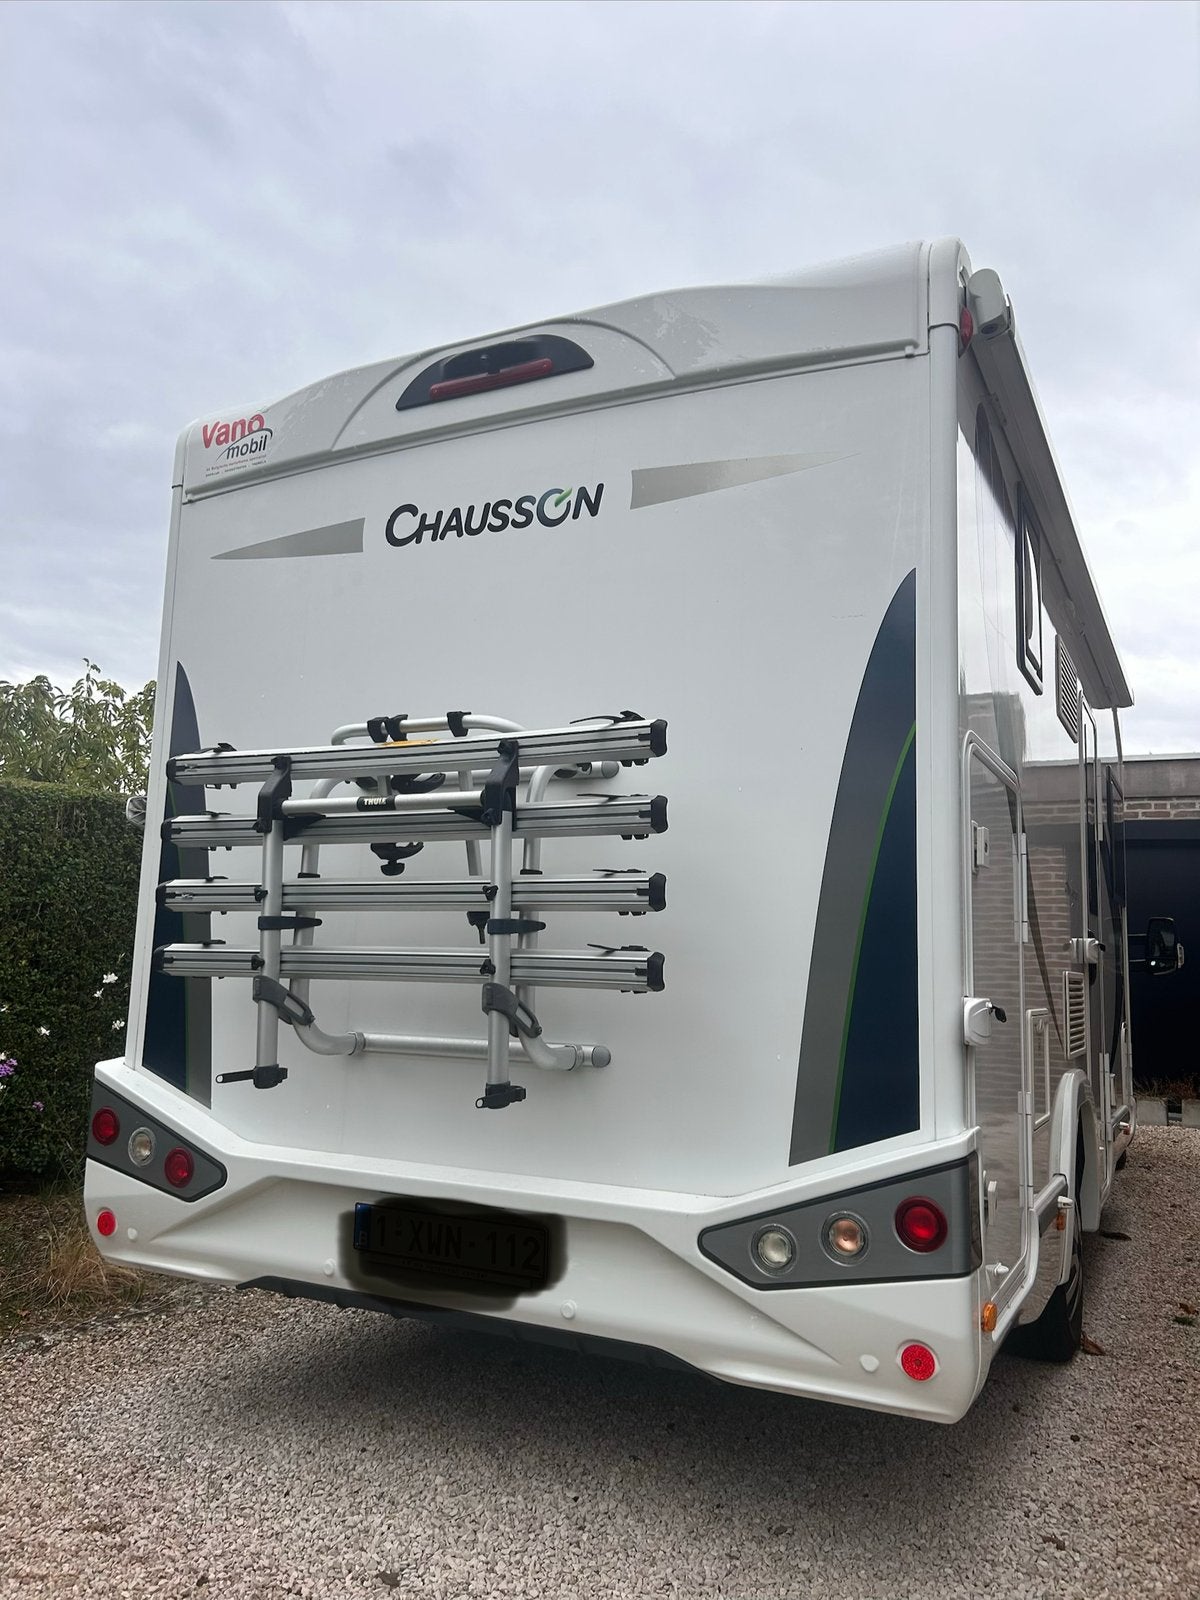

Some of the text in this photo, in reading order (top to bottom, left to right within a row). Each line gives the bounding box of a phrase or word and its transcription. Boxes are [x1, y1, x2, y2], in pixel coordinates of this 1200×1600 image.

[203, 414, 265, 448] Vano
[226, 434, 268, 459] mobil
[385, 482, 604, 547] CHAUSSON
